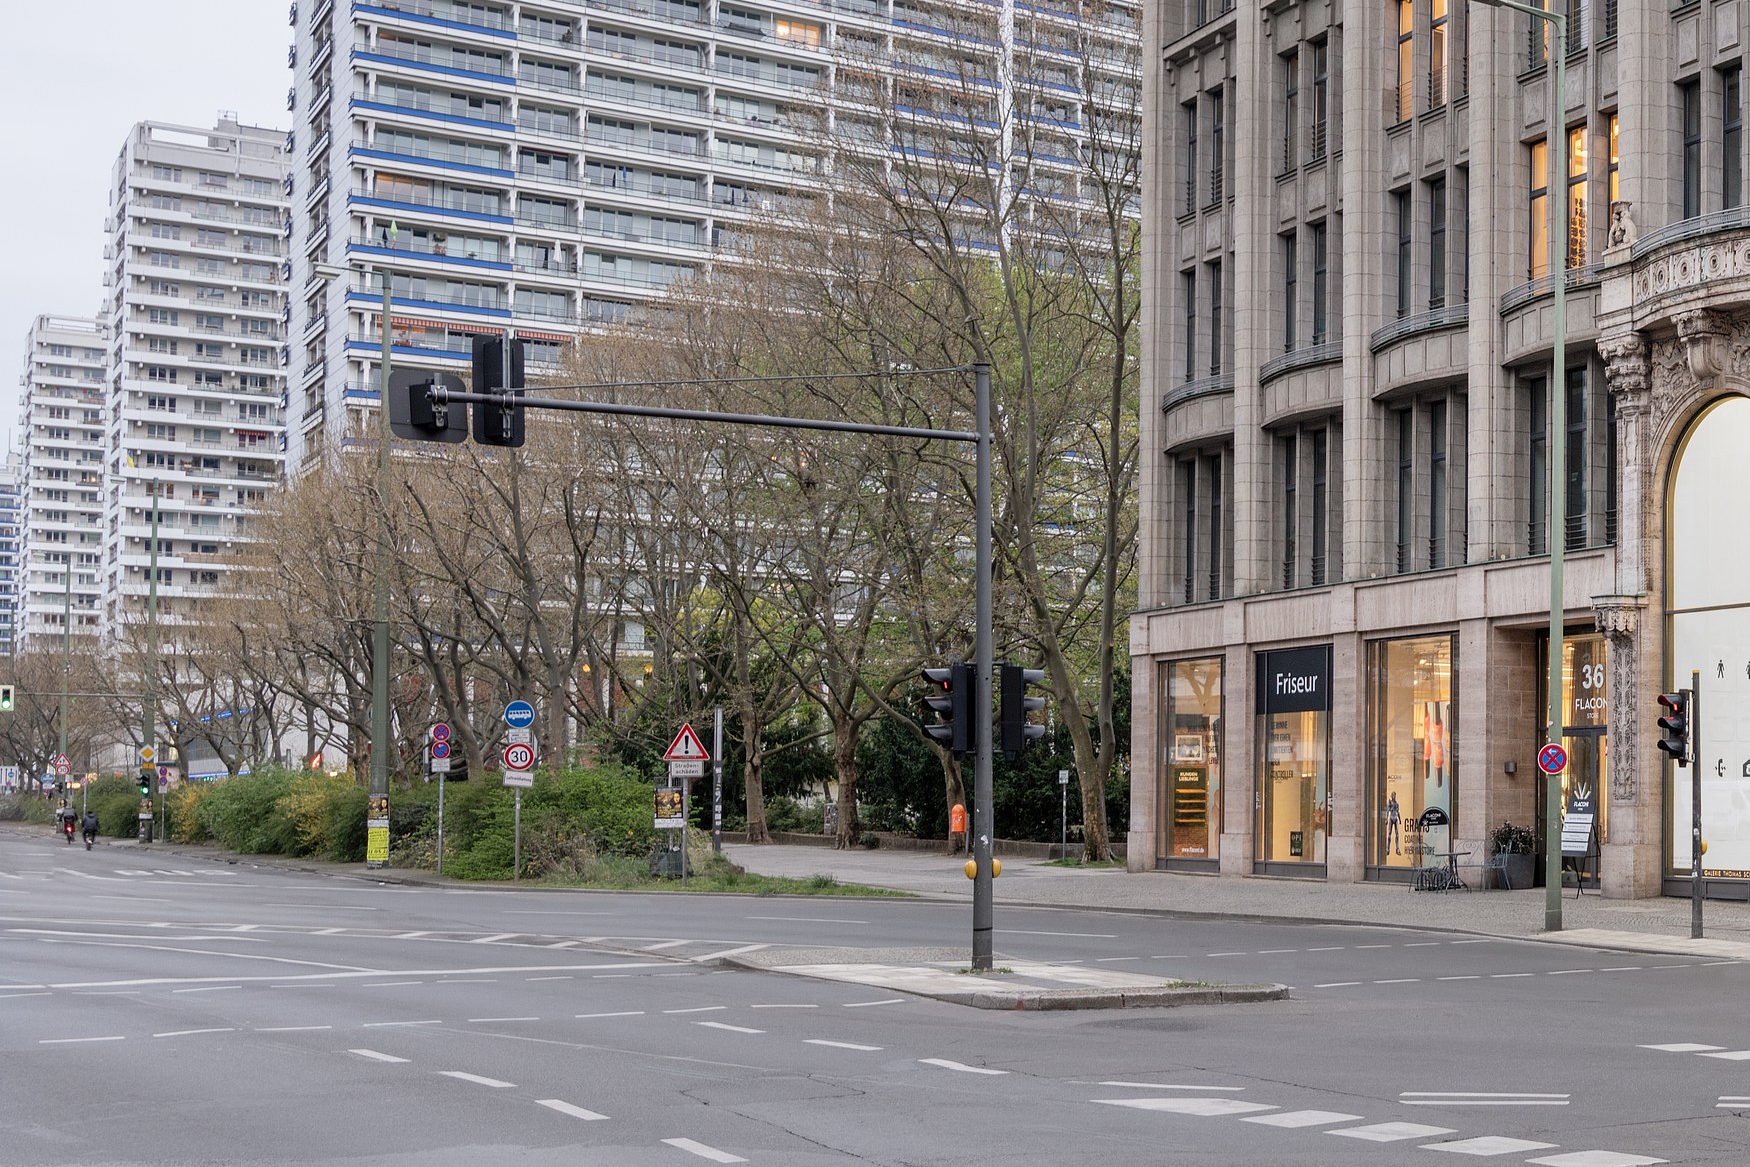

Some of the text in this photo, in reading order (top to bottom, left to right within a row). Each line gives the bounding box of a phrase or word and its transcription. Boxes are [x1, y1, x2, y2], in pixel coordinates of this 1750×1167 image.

[1276, 672, 1318, 695] Friseur
[1582, 663, 1604, 689] 36
[511, 751, 528, 763] 30
[1722, 870, 1742, 878] THOMAS
